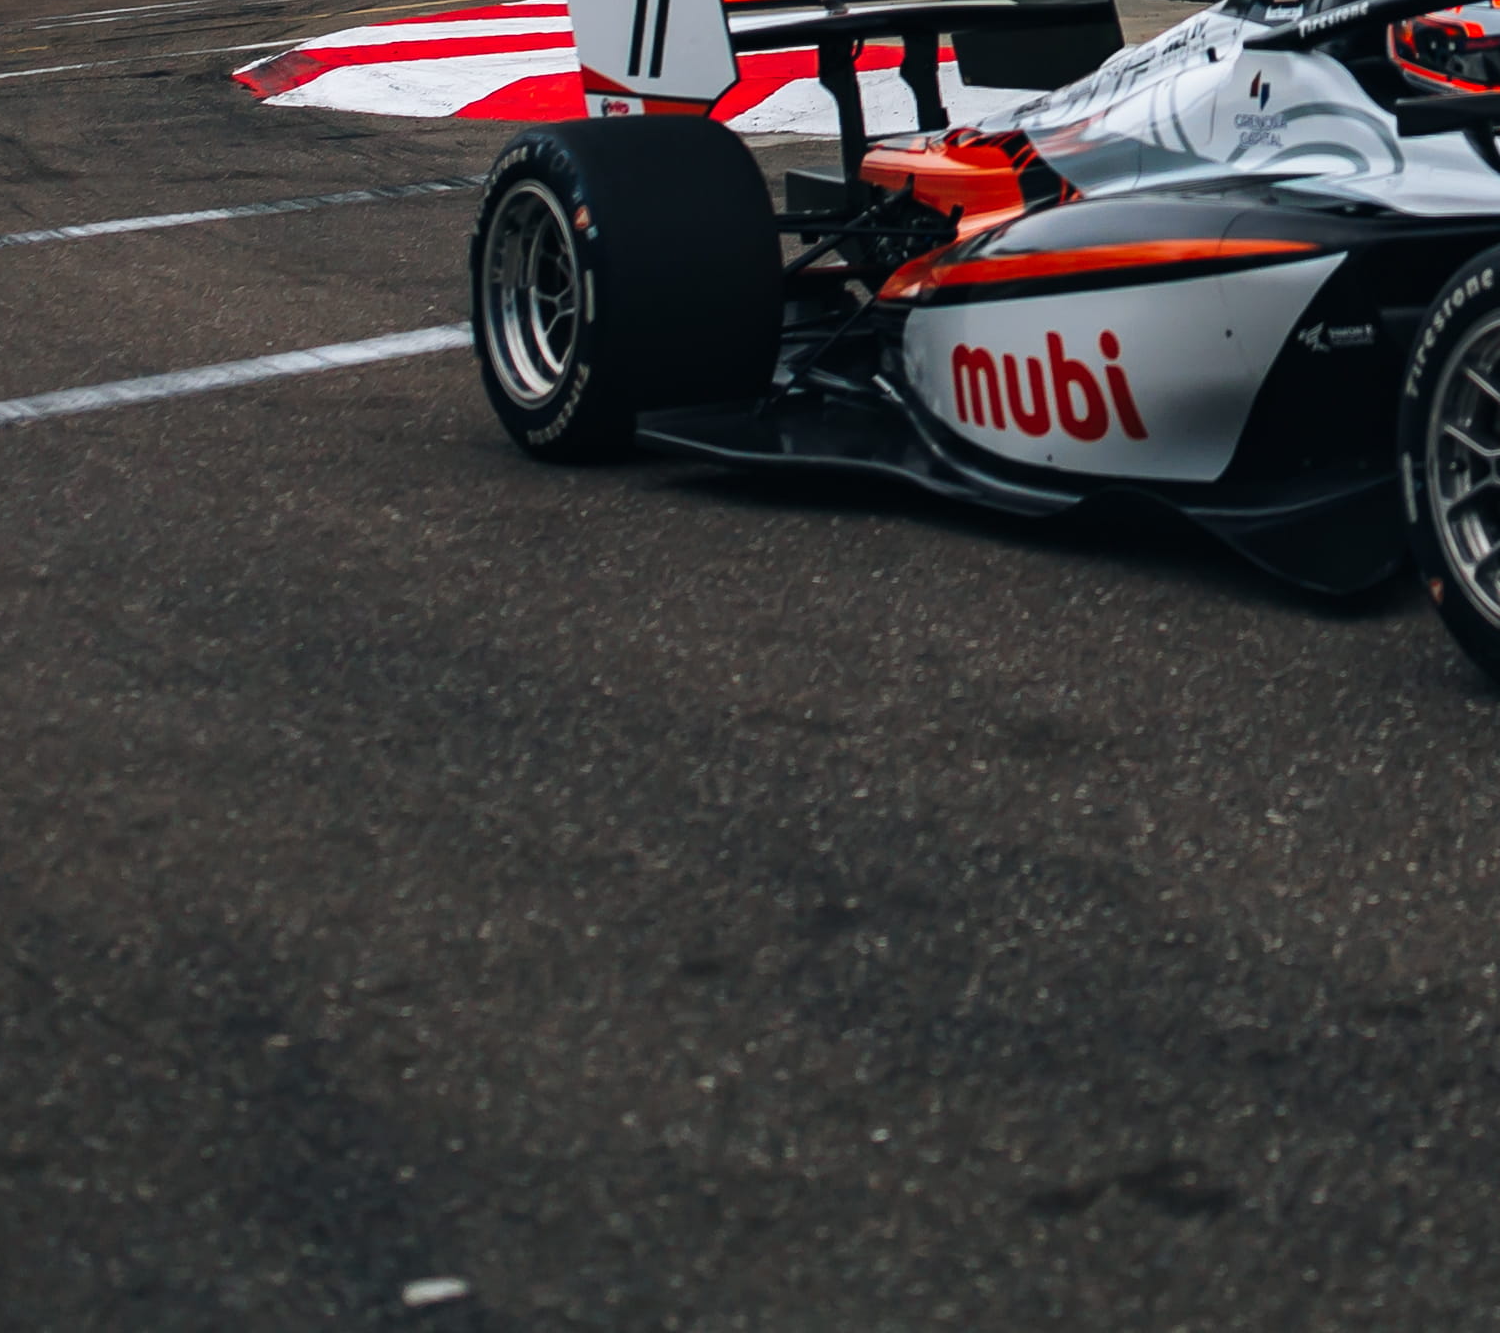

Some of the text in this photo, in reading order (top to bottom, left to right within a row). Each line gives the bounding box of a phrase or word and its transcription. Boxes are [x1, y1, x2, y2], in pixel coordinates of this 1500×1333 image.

[1299, 1, 1369, 38] Firestone
[952, 331, 1148, 442] mubi
[1406, 266, 1494, 397] Firestone
